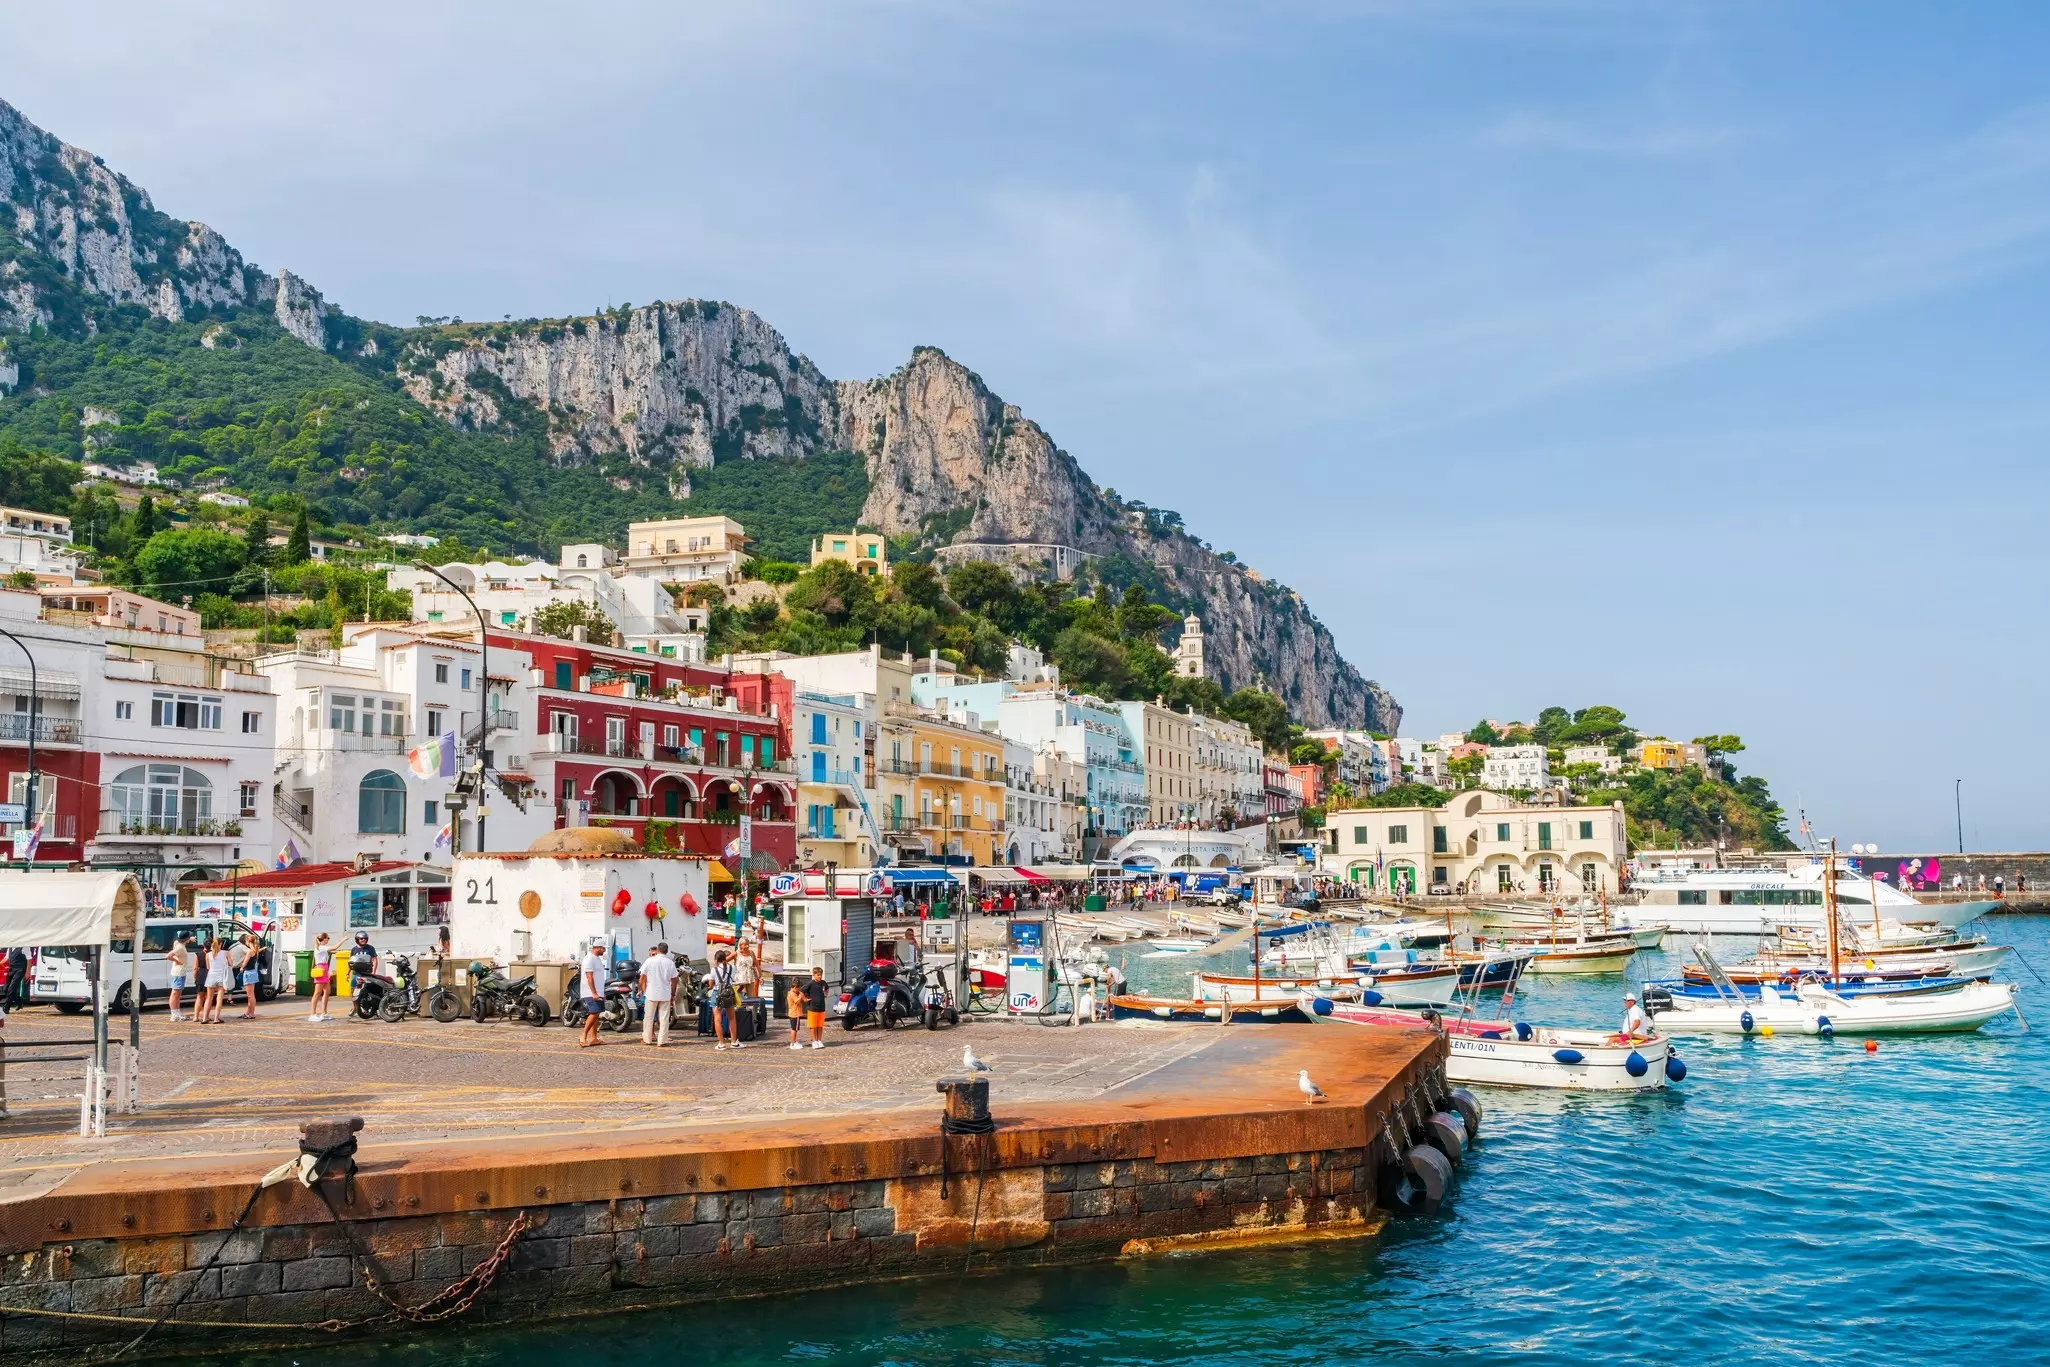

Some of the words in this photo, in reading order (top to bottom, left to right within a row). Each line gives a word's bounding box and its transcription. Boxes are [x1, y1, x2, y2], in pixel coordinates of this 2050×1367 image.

[15, 832, 33, 843] BUS
[467, 875, 498, 904] 21
[1450, 1040, 1496, 1052] LENTI/01N
